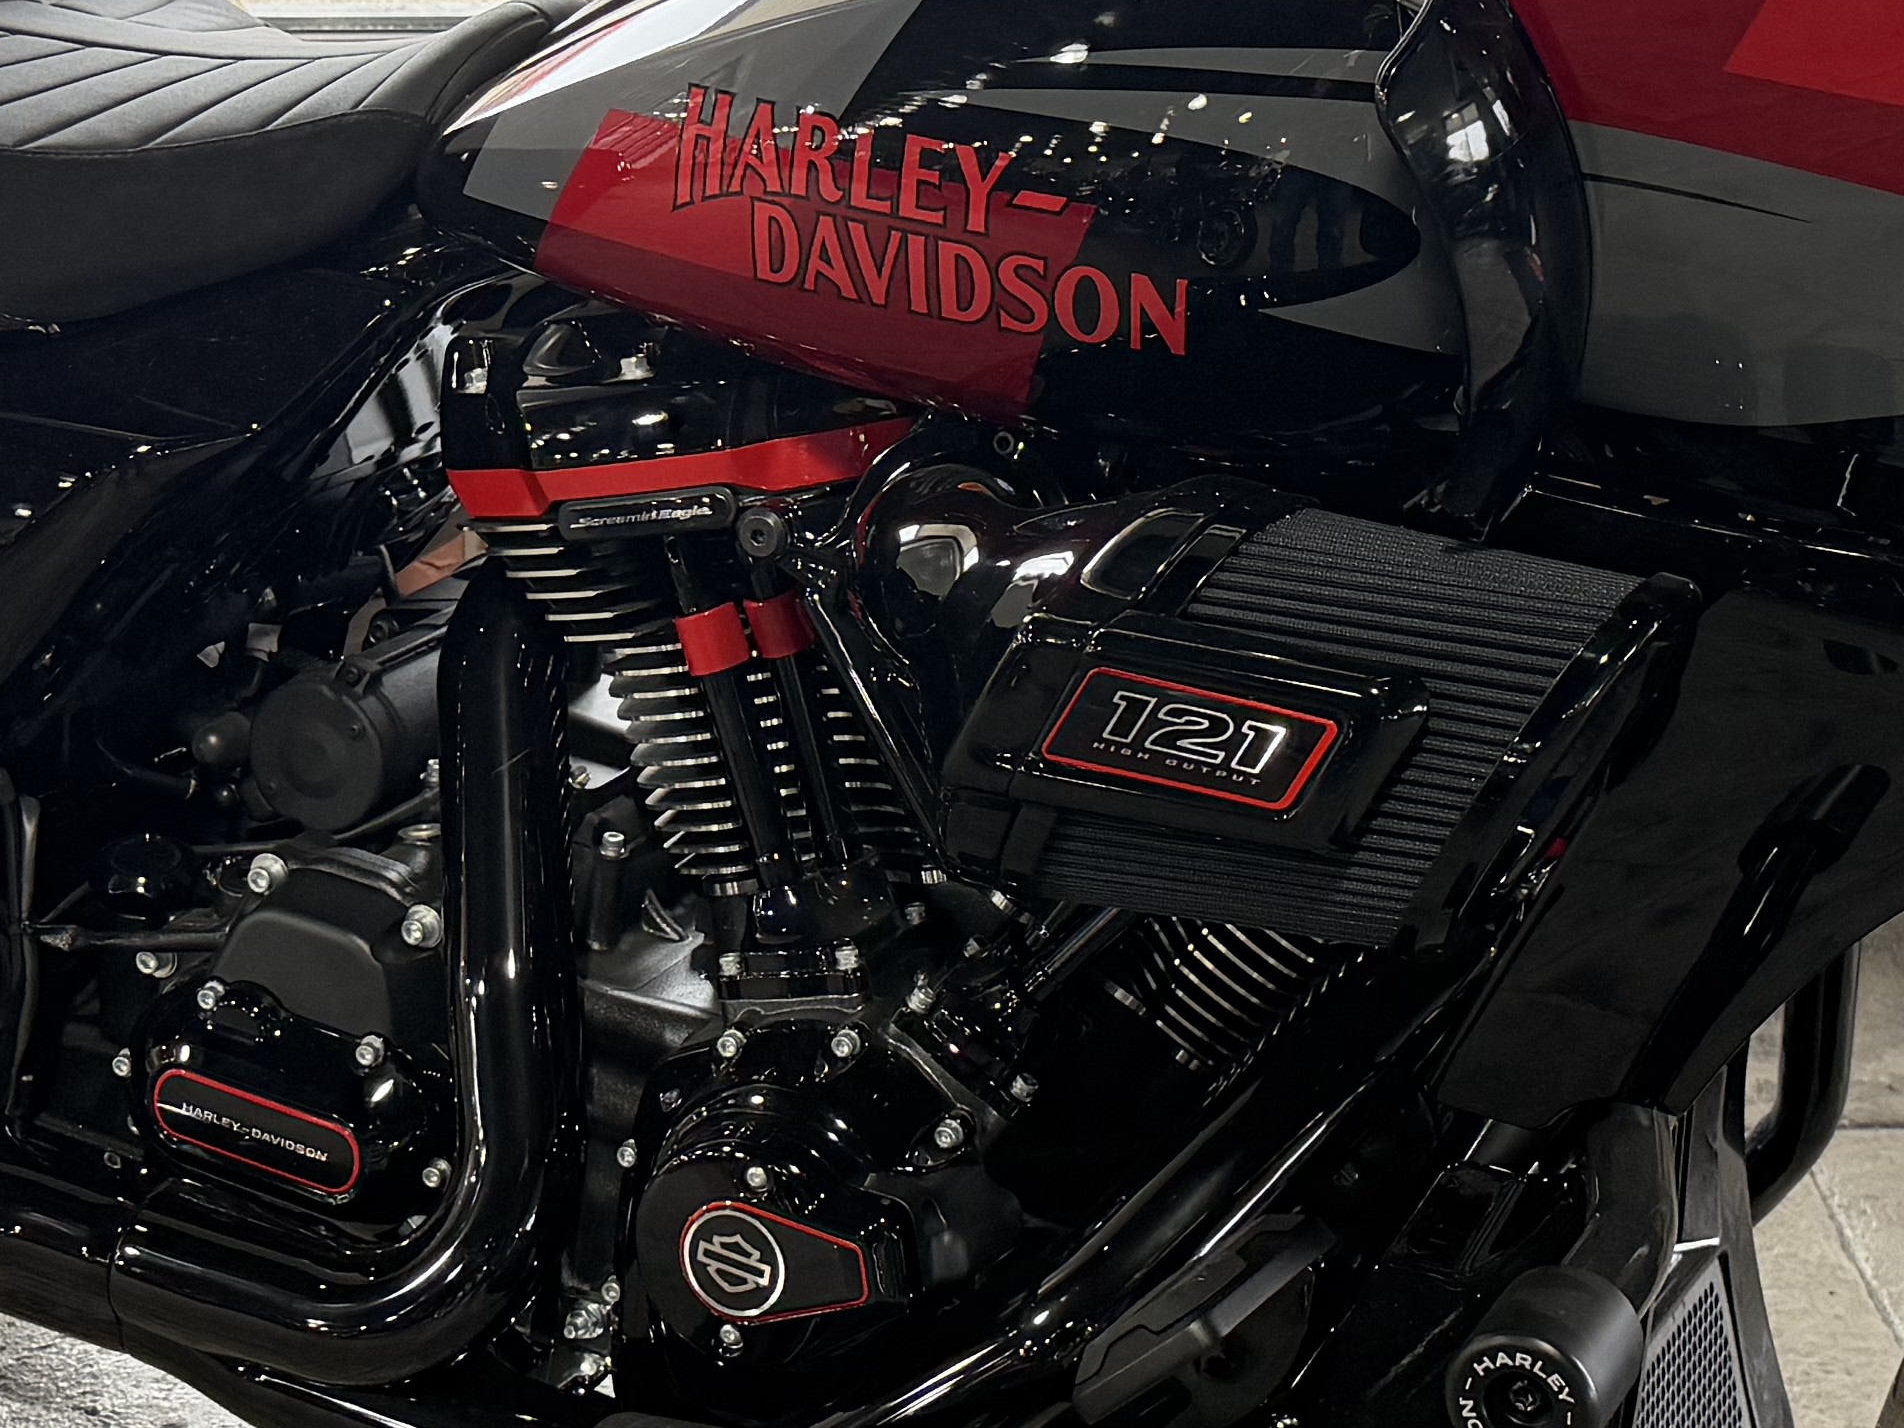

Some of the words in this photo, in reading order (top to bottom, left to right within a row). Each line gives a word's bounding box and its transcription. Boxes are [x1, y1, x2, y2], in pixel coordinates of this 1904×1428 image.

[751, 195, 1190, 357] DAVIDSON
[1092, 741, 1150, 760] HIGH
[1164, 758, 1262, 785] OUTPUT
[1102, 690, 1287, 774] 121
